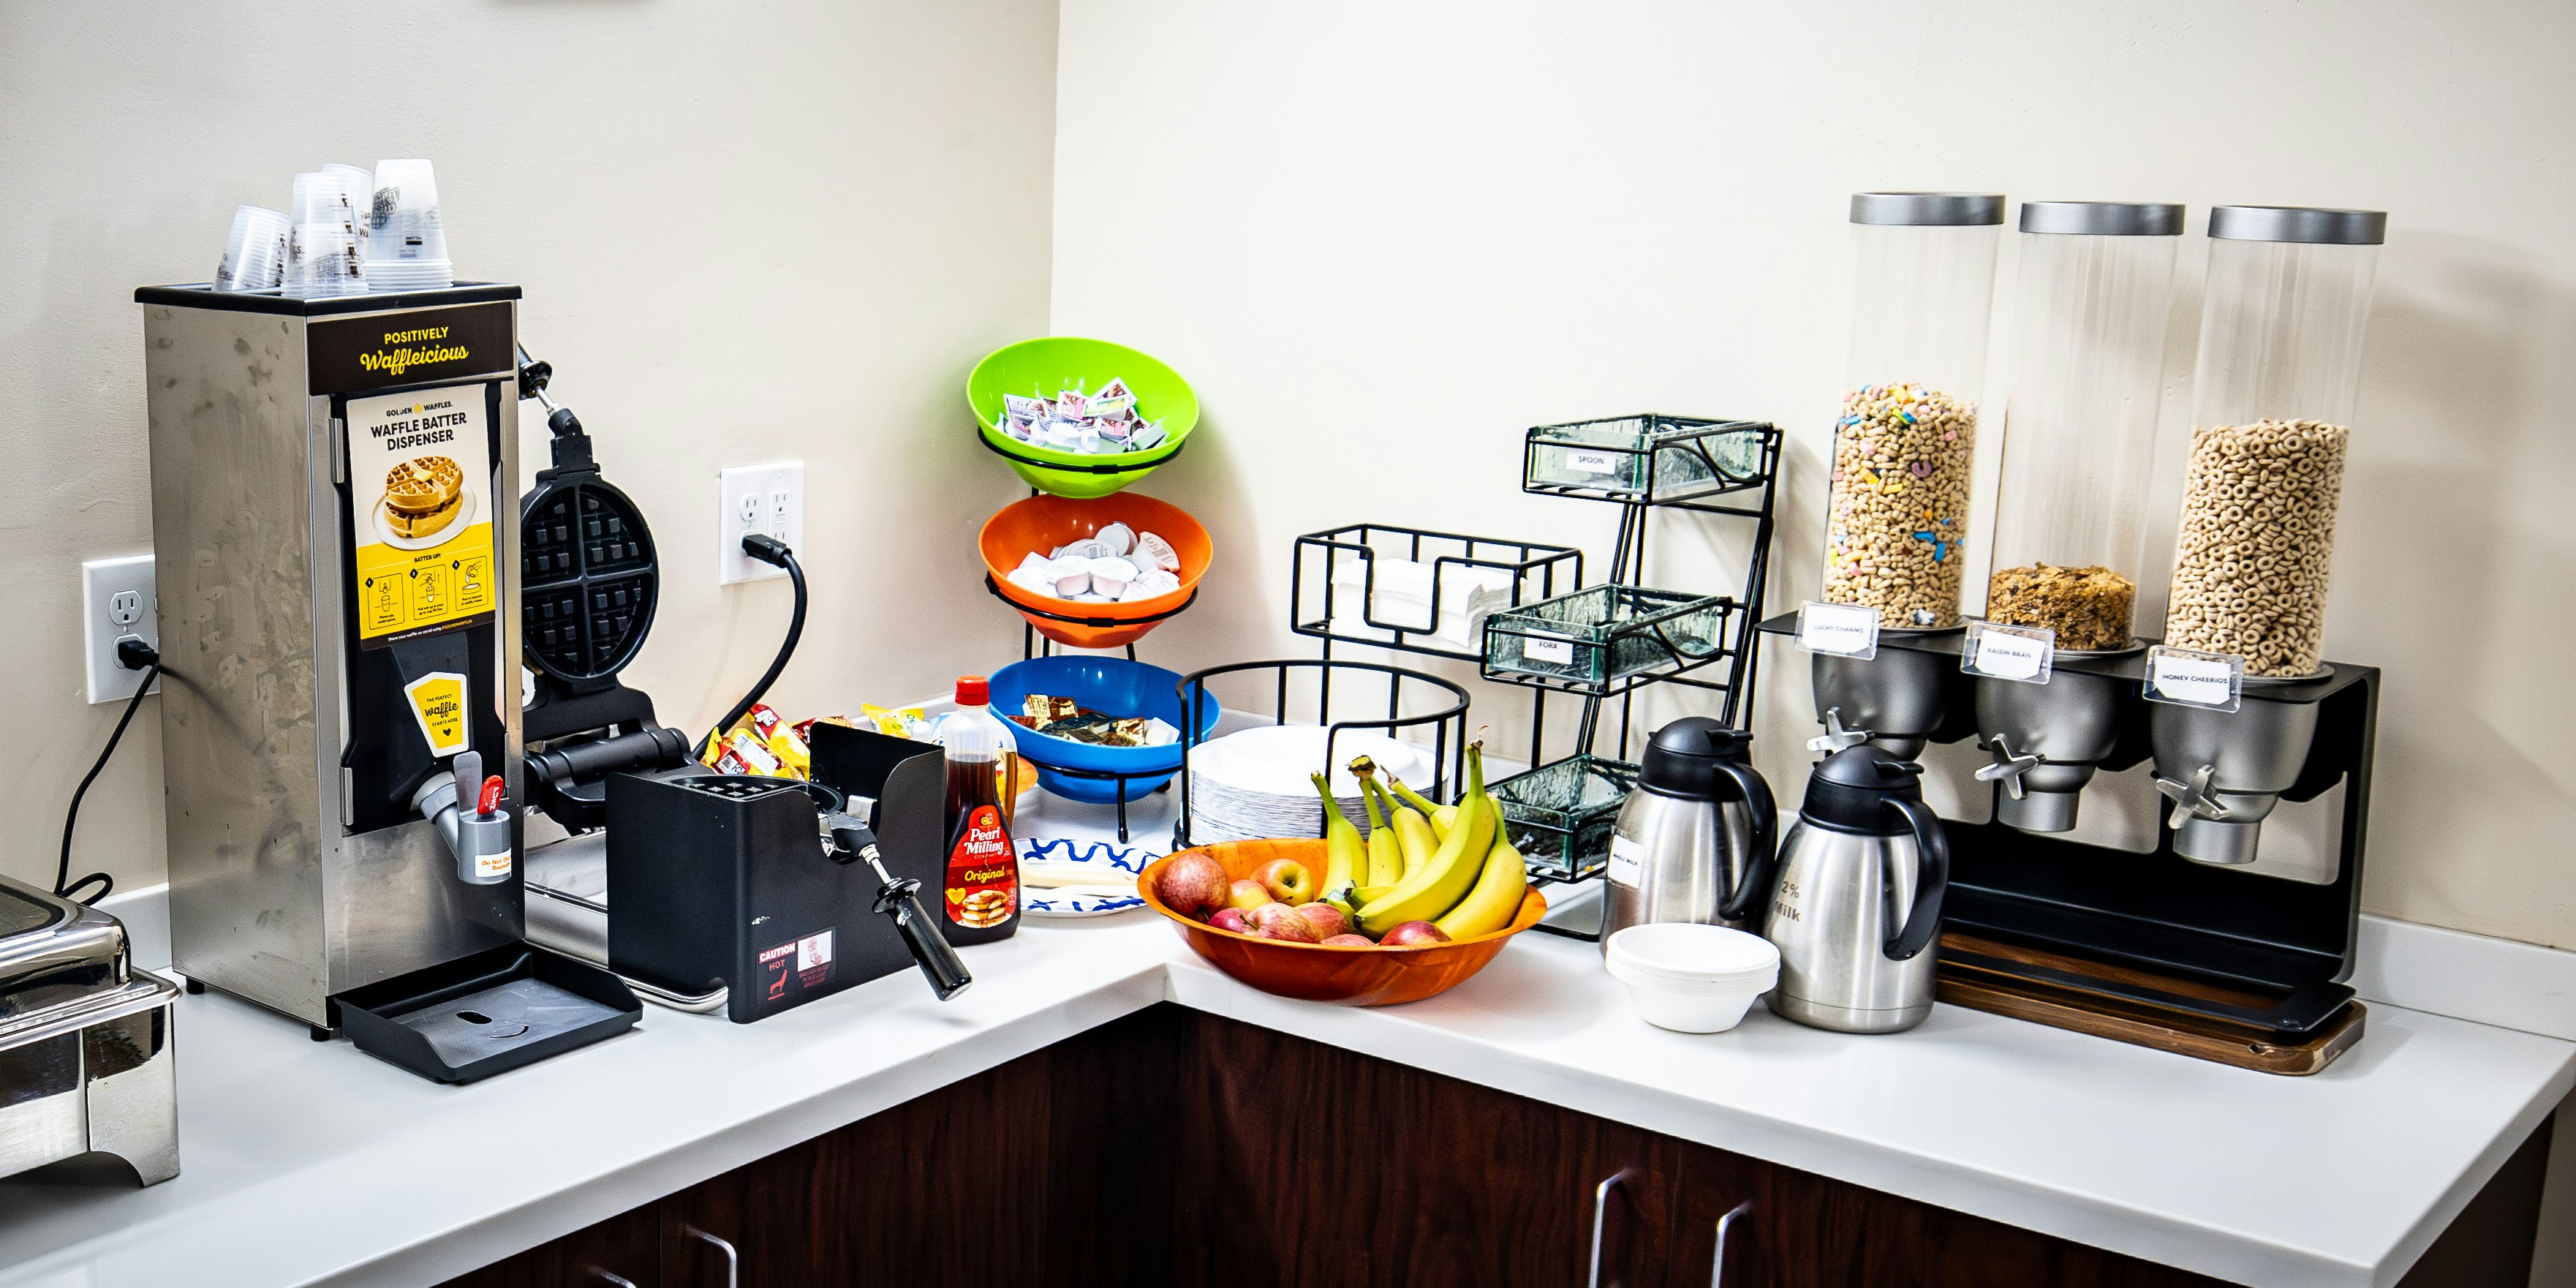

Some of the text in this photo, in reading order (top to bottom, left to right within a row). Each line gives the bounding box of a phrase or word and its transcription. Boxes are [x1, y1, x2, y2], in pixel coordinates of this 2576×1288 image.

[384, 326, 449, 345] POSITIVELY
[360, 344, 469, 376] Waffleicious
[386, 407, 412, 418] GOLDEN
[371, 412, 467, 439] WAFFLE BATTER
[387, 429, 455, 451] DISPENSER
[1578, 456, 1604, 464] SPOON
[414, 554, 432, 563] BATTER
[1539, 641, 1558, 649] FORK
[1987, 647, 2031, 658] RAISIN BRAN
[2191, 676, 2228, 684] CHEERIOS
[424, 701, 458, 718] waffle
[970, 826, 1001, 842] Pearl
[964, 841, 1005, 855] Milling
[964, 865, 1005, 884] Original
[1781, 881, 1799, 898] 2%
[759, 942, 796, 964] CAUTION
[768, 960, 786, 971] HOT
